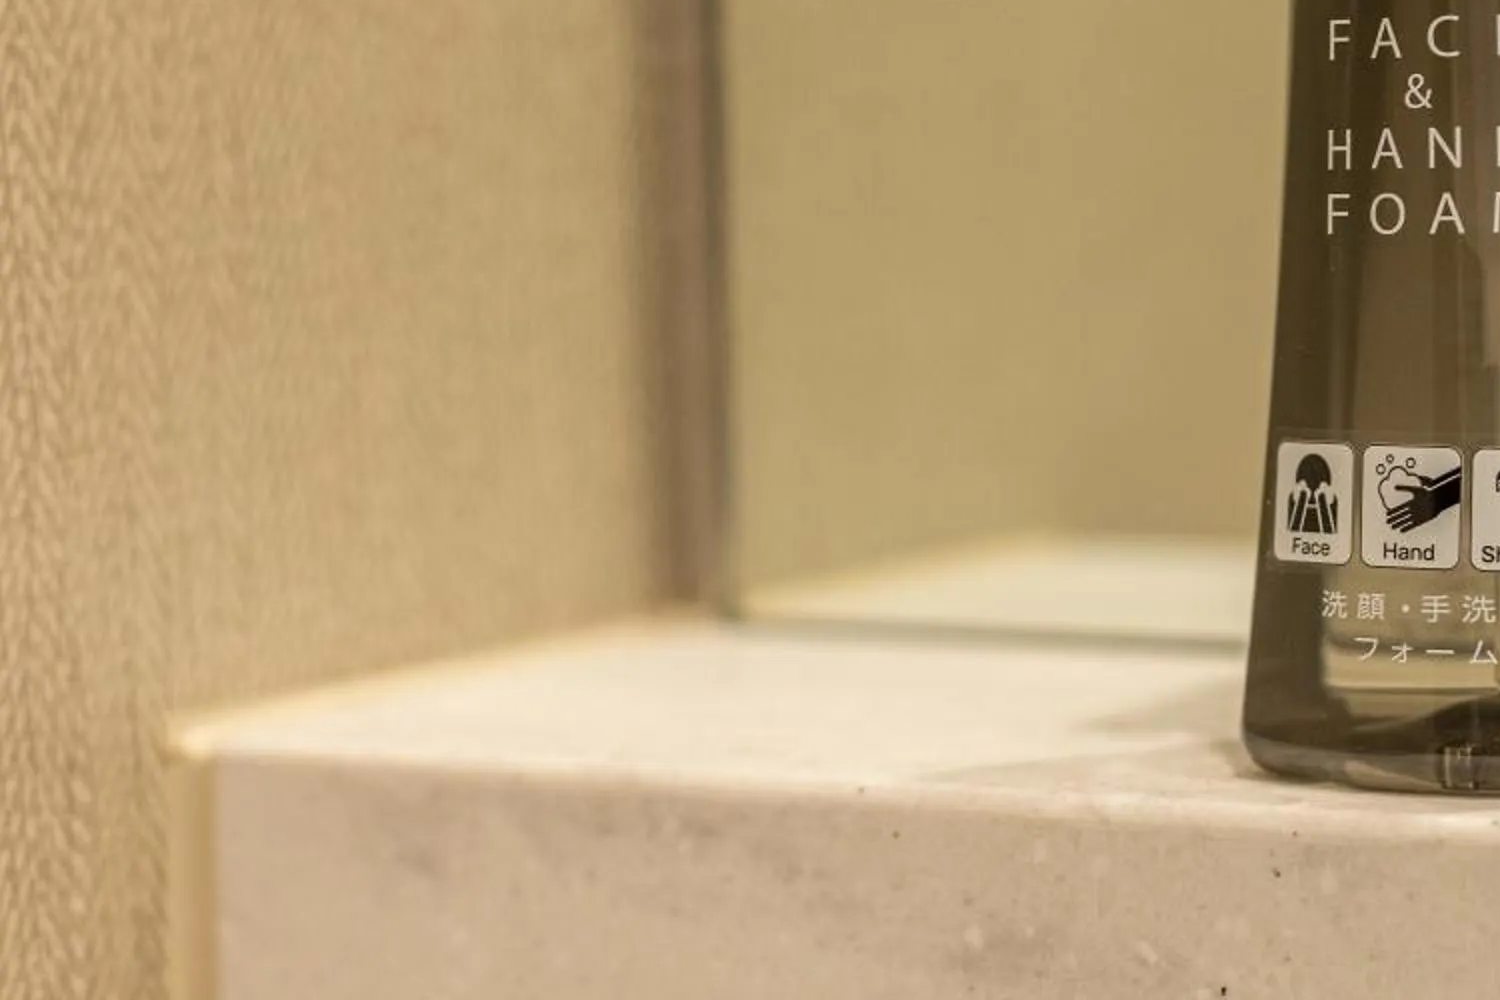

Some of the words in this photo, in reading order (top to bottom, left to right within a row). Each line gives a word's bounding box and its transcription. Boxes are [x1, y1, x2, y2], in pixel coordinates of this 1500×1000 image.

[1403, 72, 1434, 110] &
[1291, 537, 1332, 558] Face
[1382, 541, 1436, 562] Hand
[1352, 636, 1499, 666] フォーム
